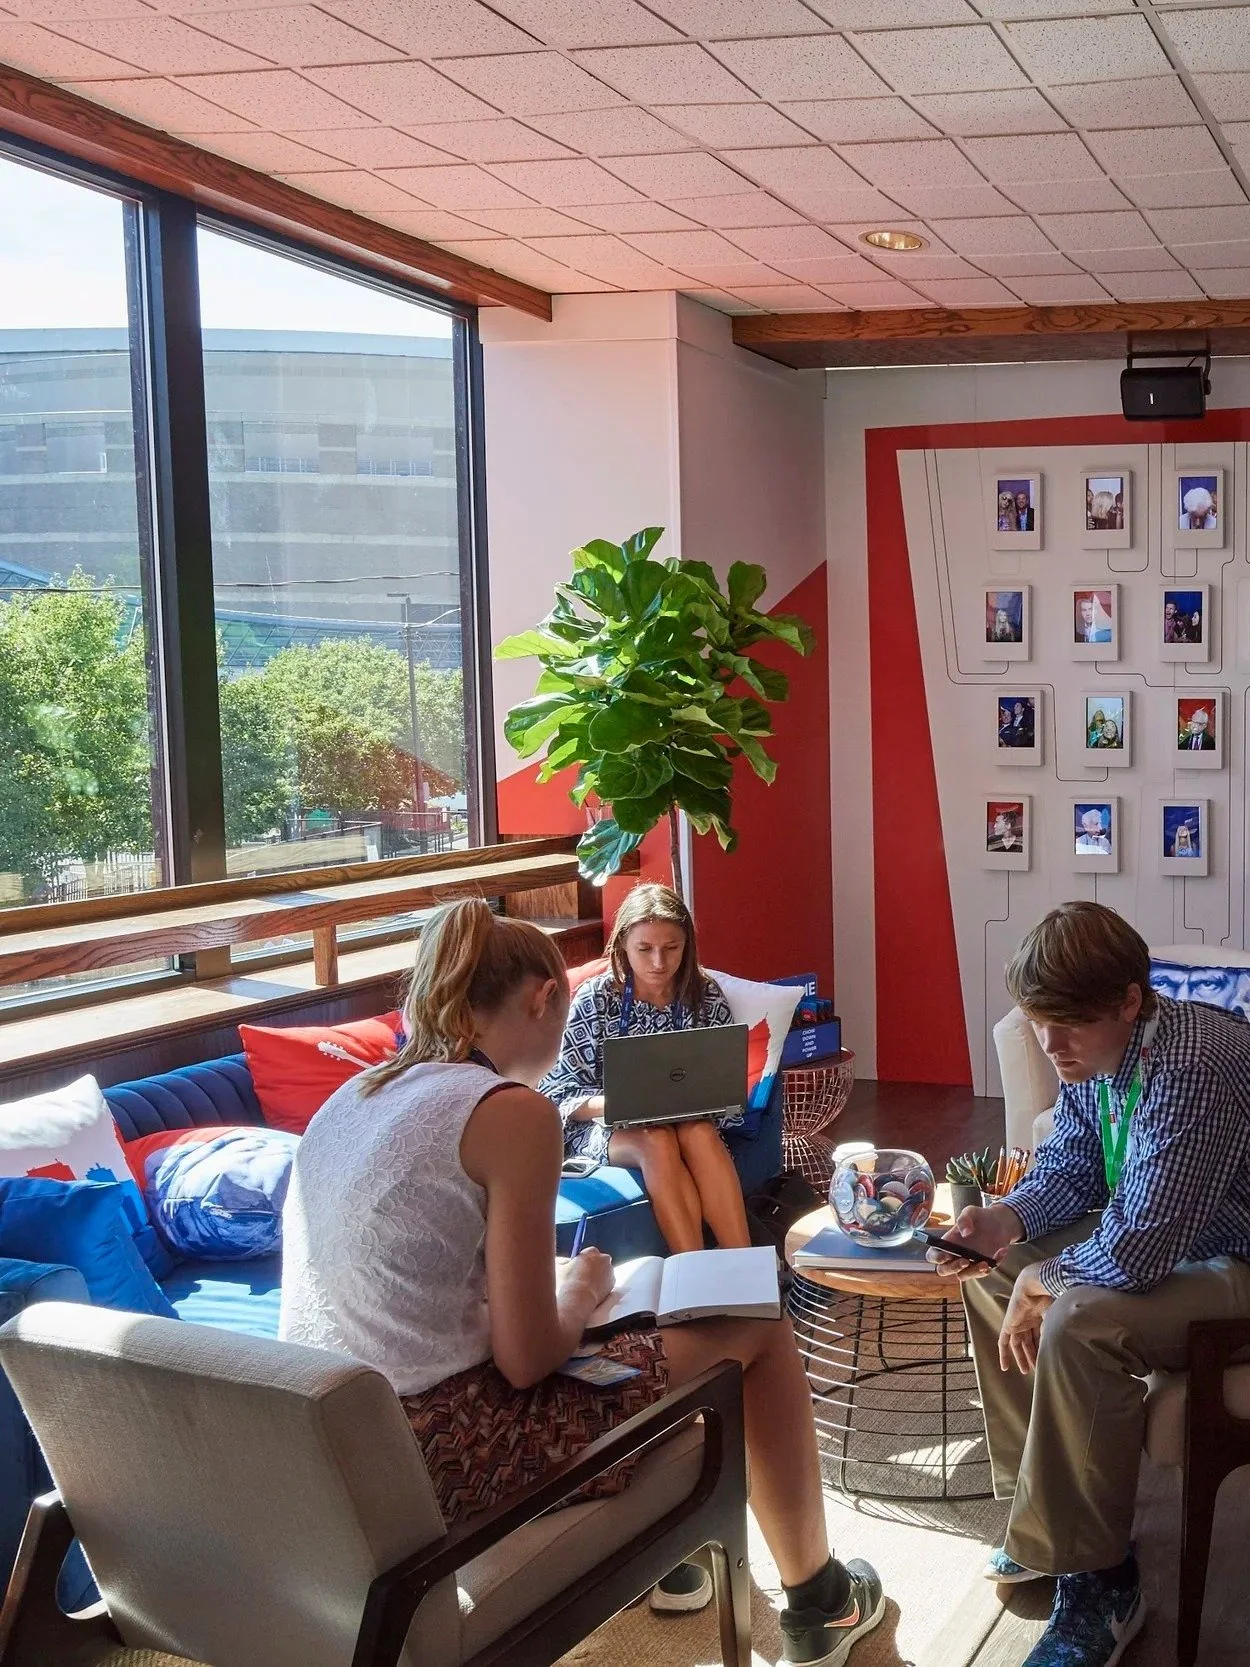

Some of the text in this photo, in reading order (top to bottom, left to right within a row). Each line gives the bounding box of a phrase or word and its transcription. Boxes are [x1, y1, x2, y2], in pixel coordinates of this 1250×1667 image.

[802, 1028, 816, 1036] CHOW
[802, 1034, 816, 1042] DOWN
[802, 1045, 817, 1053] POWER
